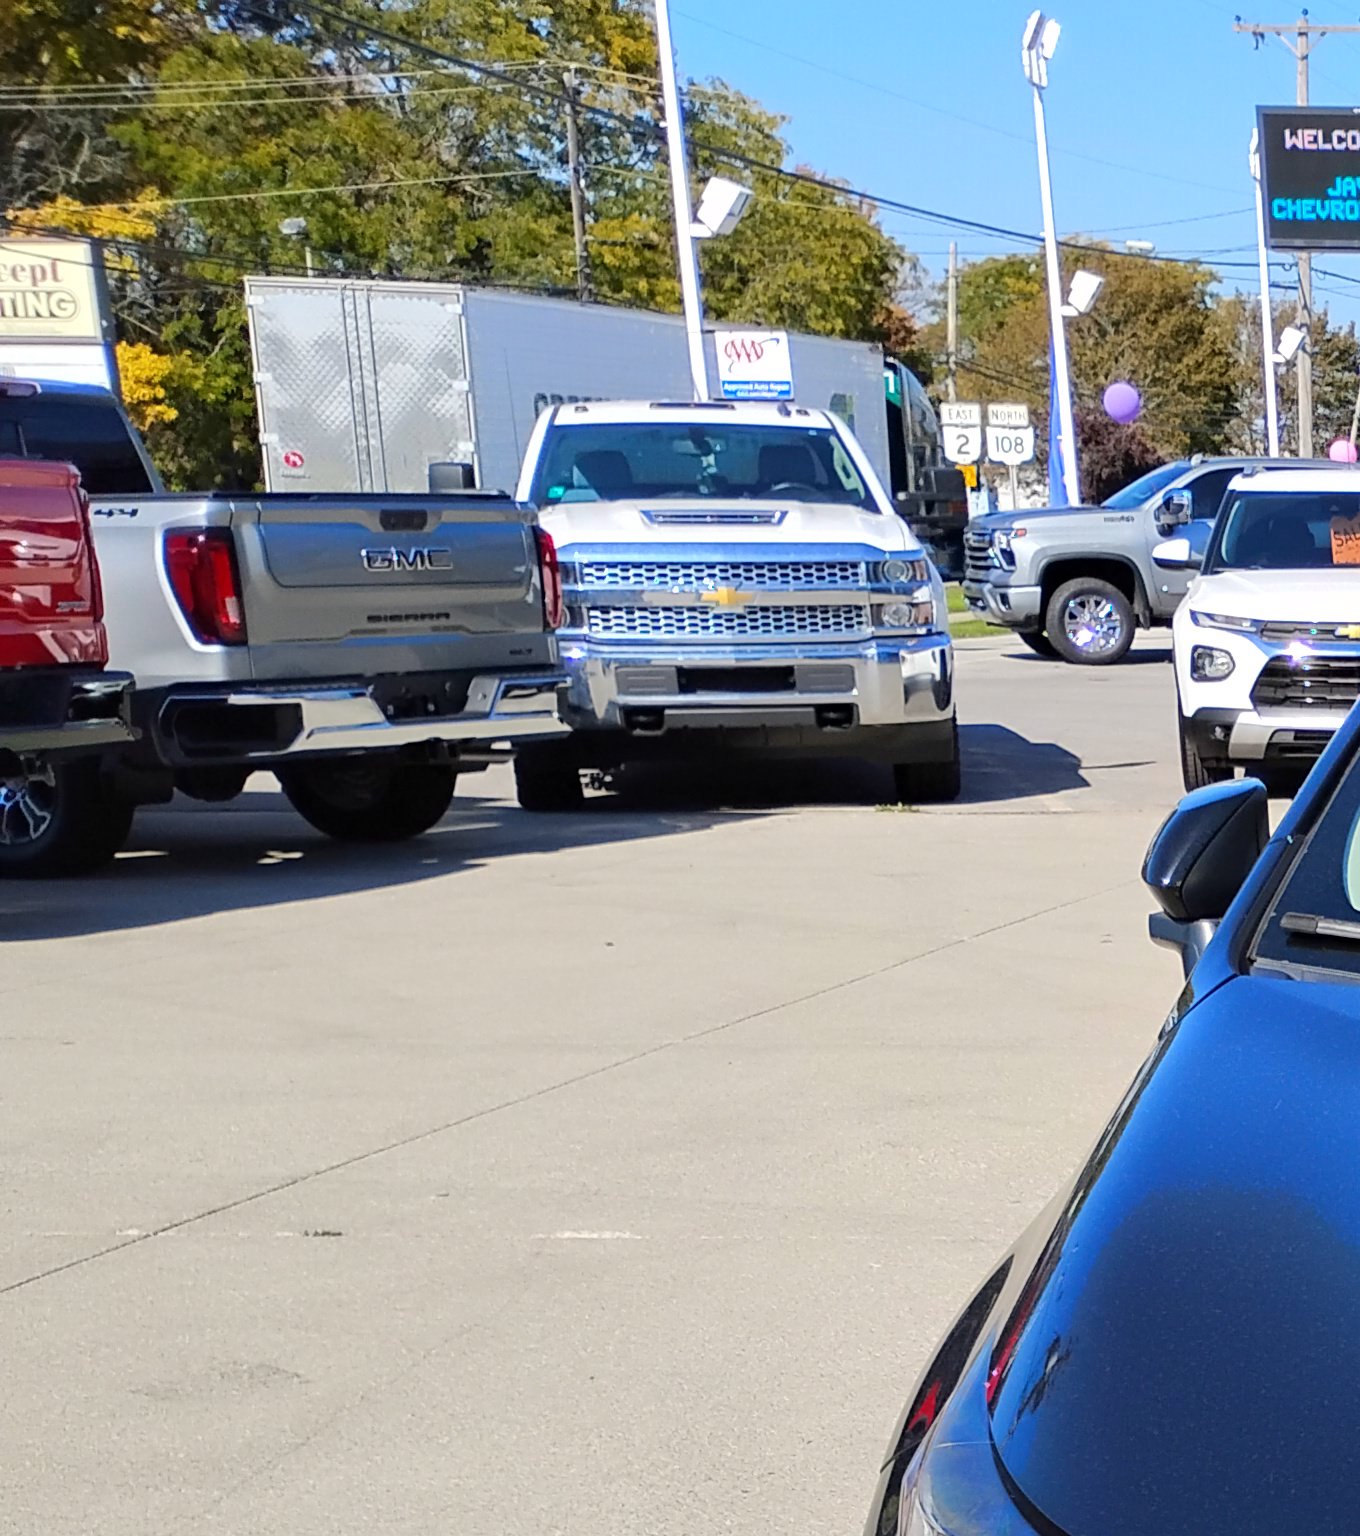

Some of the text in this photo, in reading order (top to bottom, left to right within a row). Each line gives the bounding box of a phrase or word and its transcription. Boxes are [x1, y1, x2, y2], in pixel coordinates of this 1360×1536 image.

[948, 408, 973, 420] EAST
[991, 409, 1026, 420] NORTH
[956, 433, 970, 455] 2
[995, 435, 1025, 454] 108
[361, 547, 453, 572] GMC
